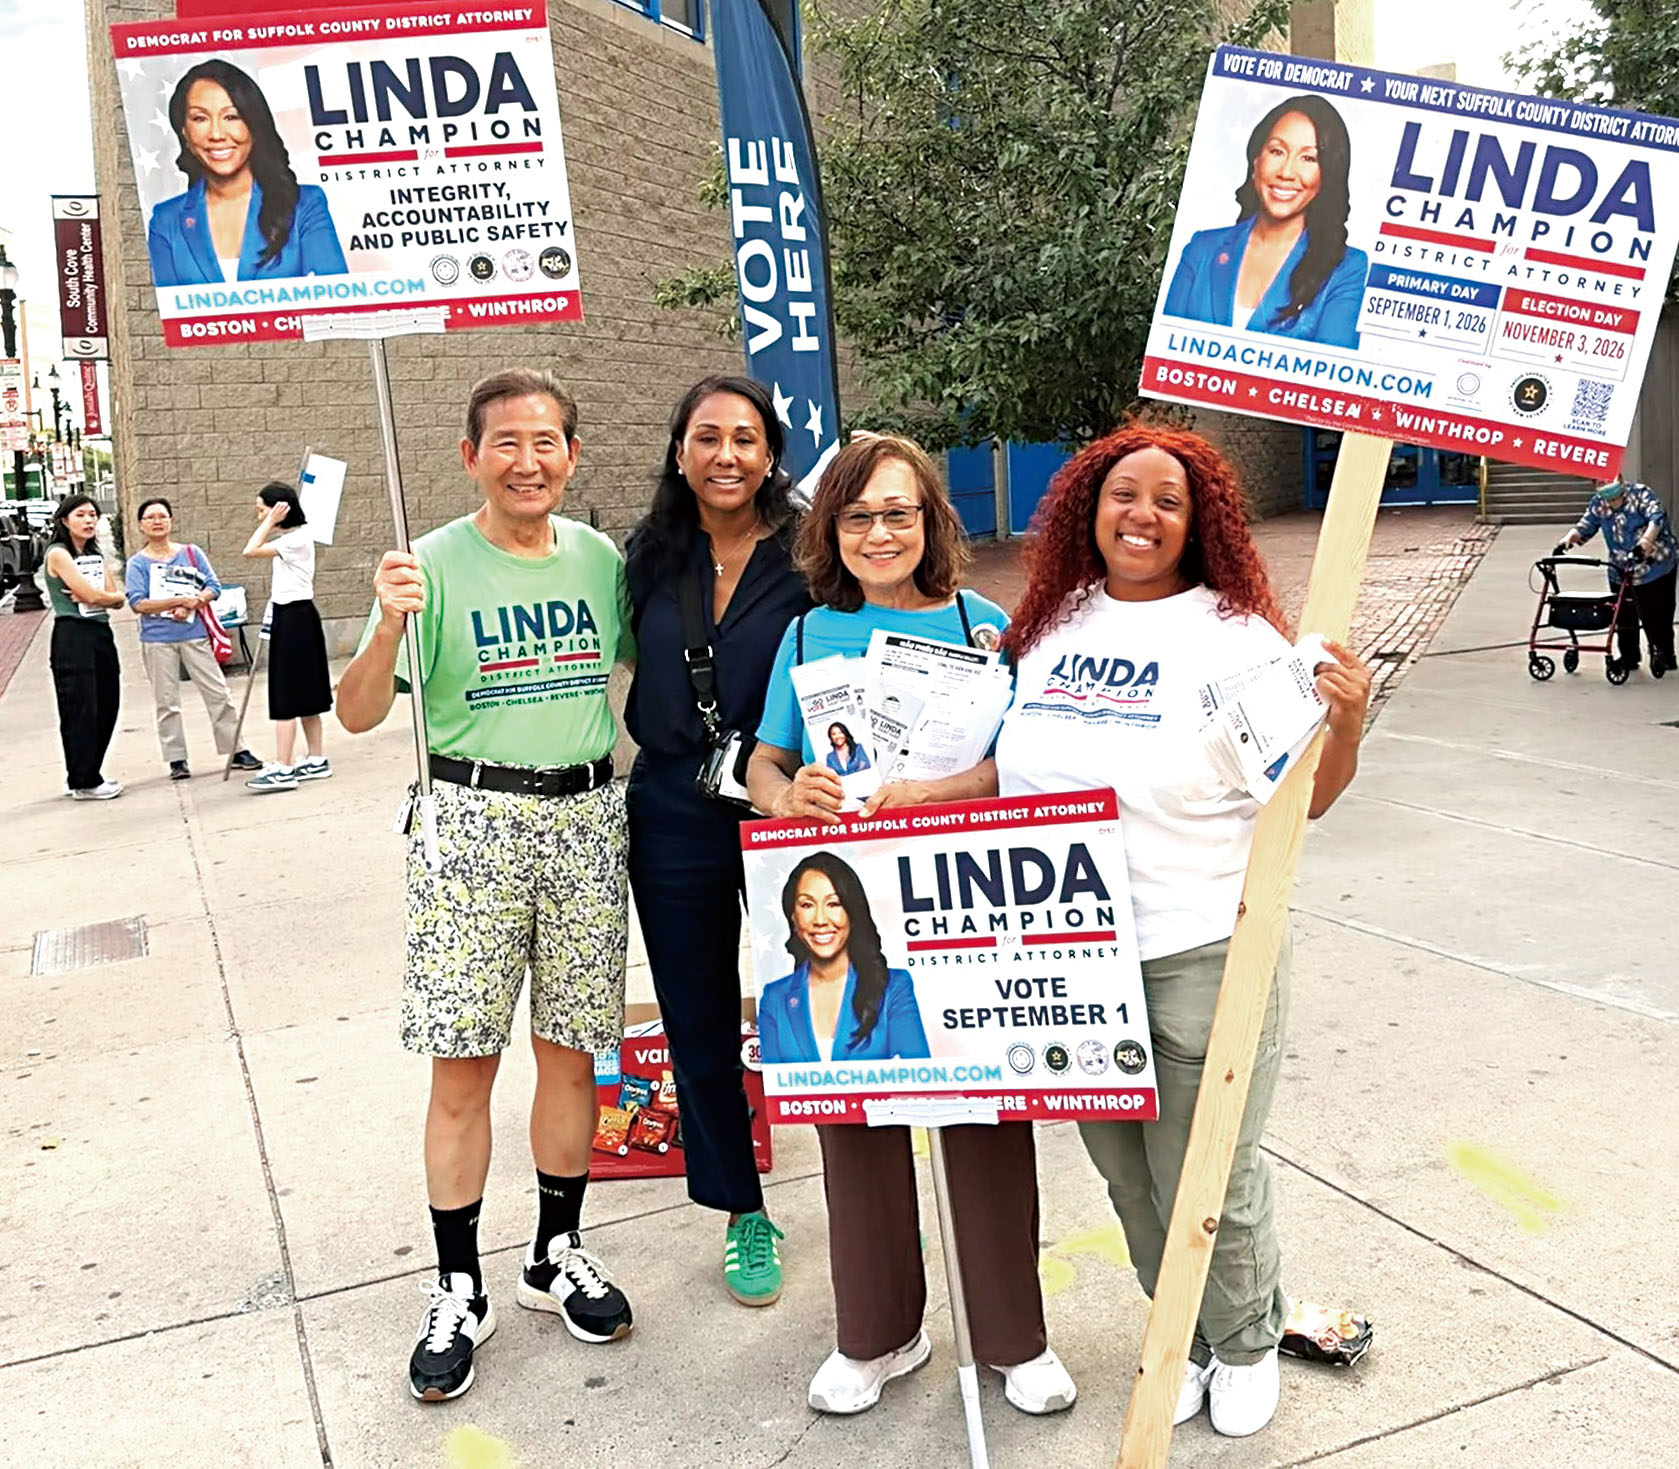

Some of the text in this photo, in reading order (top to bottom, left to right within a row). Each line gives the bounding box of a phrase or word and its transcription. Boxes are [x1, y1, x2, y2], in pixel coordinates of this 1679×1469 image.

[127, 8, 533, 49] DEMOCRAT FOR SUFFOLK COUNTY DISTRICT ATTORNEY
[304, 51, 538, 126] LINDA
[1223, 53, 1257, 75] VOTE
[1257, 59, 1284, 80] FOR
[1284, 63, 1354, 92] DEMOCRAT
[1384, 78, 1420, 103] YOUR
[1419, 84, 1456, 108] NEXT
[1457, 90, 1516, 118] SUFFOLK
[1515, 101, 1571, 127] COUNTY
[1570, 111, 1631, 138] DISTRICT
[314, 117, 542, 151] CHAMPION
[320, 158, 546, 183] DISTRICT ATTORNEY
[424, 148, 439, 161] for
[389, 181, 511, 205] INTEGRITY,
[1390, 121, 1655, 234] LINDA
[362, 200, 550, 229] ACCOUNTABILITY
[1385, 195, 1653, 262] CHAMPION
[350, 220, 568, 251] AND PUBLIC SAFETY
[727, 137, 783, 356] VOTE
[771, 136, 820, 352] HERE
[1498, 241, 1520, 256] for
[64, 249, 81, 308] South Cove
[80, 223, 98, 334] Community Health Center
[1374, 240, 1642, 299] DISTRICT ATTORNEY
[175, 277, 426, 310] LINDACHAMPION.COM
[1387, 272, 1480, 301] PRIMARY DAY
[179, 318, 256, 339] BOSTON
[468, 296, 569, 318] WINTHROP
[1367, 295, 1487, 334] SEPTEMBER 1, 2026
[1520, 297, 1623, 327] ELECTION DAY
[1502, 320, 1625, 360] NOVEMBER 3, 2026
[1167, 333, 1433, 399] LINDACHAMPION.COM
[1155, 365, 1611, 468] BOSTON CHELSEA WINTHROP REVERE
[1563, 423, 1607, 437] LEARN MORE
[1572, 417, 1602, 429] SCAN TO
[471, 599, 598, 648] LINDA
[478, 638, 601, 663] CHAMPION
[480, 669, 540, 683] DISTRICT
[1050, 653, 1159, 687] LINDA
[469, 701, 500, 711] BOSTON
[506, 697, 544, 707] CHELSEA
[550, 691, 579, 700] REVERE
[1046, 676, 1153, 698] CHAMPION
[751, 801, 1105, 843] DEMOCRAT FOR SUFFOLK COUNTY DISTRICT ATTORNEY
[897, 842, 1112, 913] LINDA
[904, 906, 1115, 937] CHAMPION
[1001, 934, 1017, 947] for
[907, 947, 1119, 967] DISTRICT ATTORNEY
[994, 976, 1068, 1000] VOTE
[942, 1002, 1130, 1030] SEPTEMBER 1
[777, 1065, 1003, 1088] LINDACHAMPION.COM
[779, 1099, 847, 1116] BOSTON
[1044, 1094, 1145, 1111] WINTHROP
